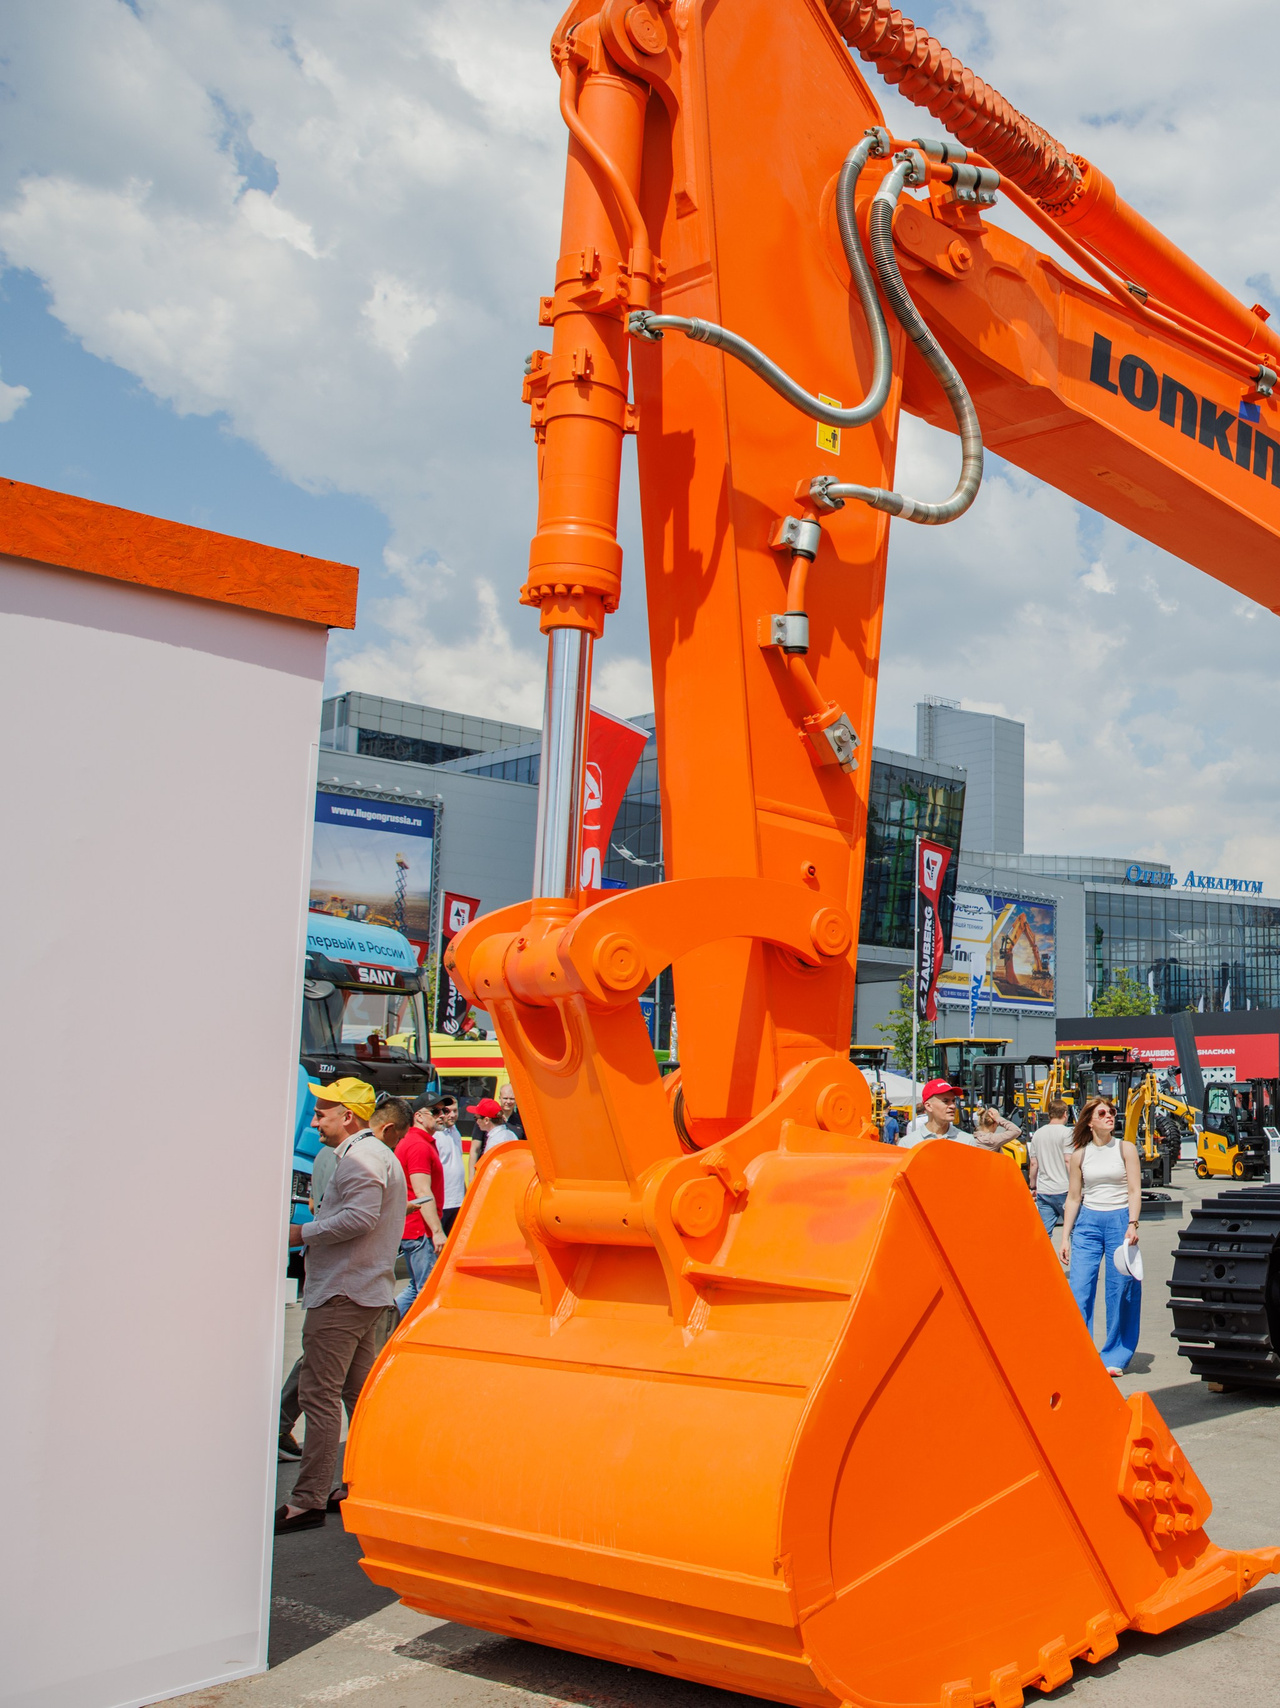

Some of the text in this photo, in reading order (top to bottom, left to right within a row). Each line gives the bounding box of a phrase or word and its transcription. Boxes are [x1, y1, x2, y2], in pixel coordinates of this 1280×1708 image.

[331, 806, 422, 826] www.liugongrussia.ru
[308, 935, 405, 960] первый в России
[920, 905, 934, 993] ZAUBERG
[358, 967, 397, 986] SANY
[1141, 1049, 1175, 1057] ZAUBERG
